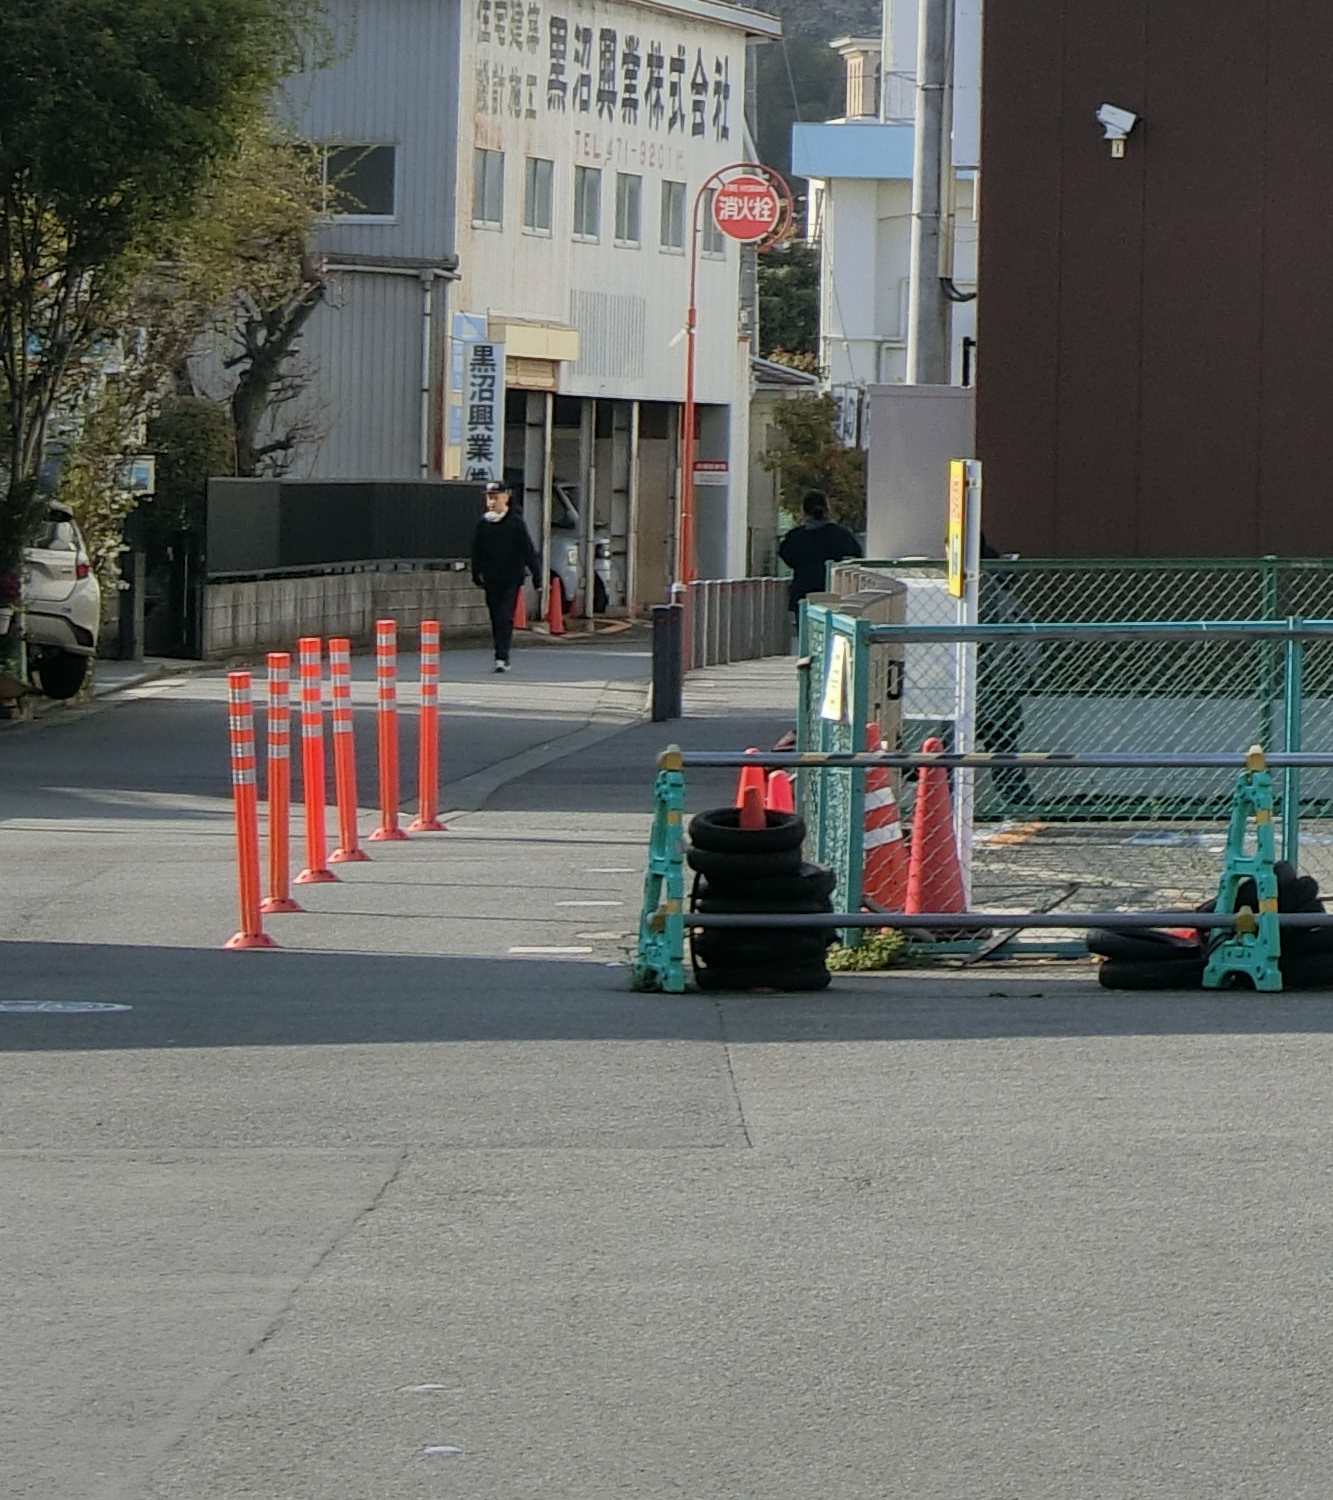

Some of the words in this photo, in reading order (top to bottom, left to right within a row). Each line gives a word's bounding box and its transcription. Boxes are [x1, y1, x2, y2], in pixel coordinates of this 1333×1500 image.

[547, 14, 730, 143] 黒沼興業株式会社
[718, 195, 774, 222] 消火栓
